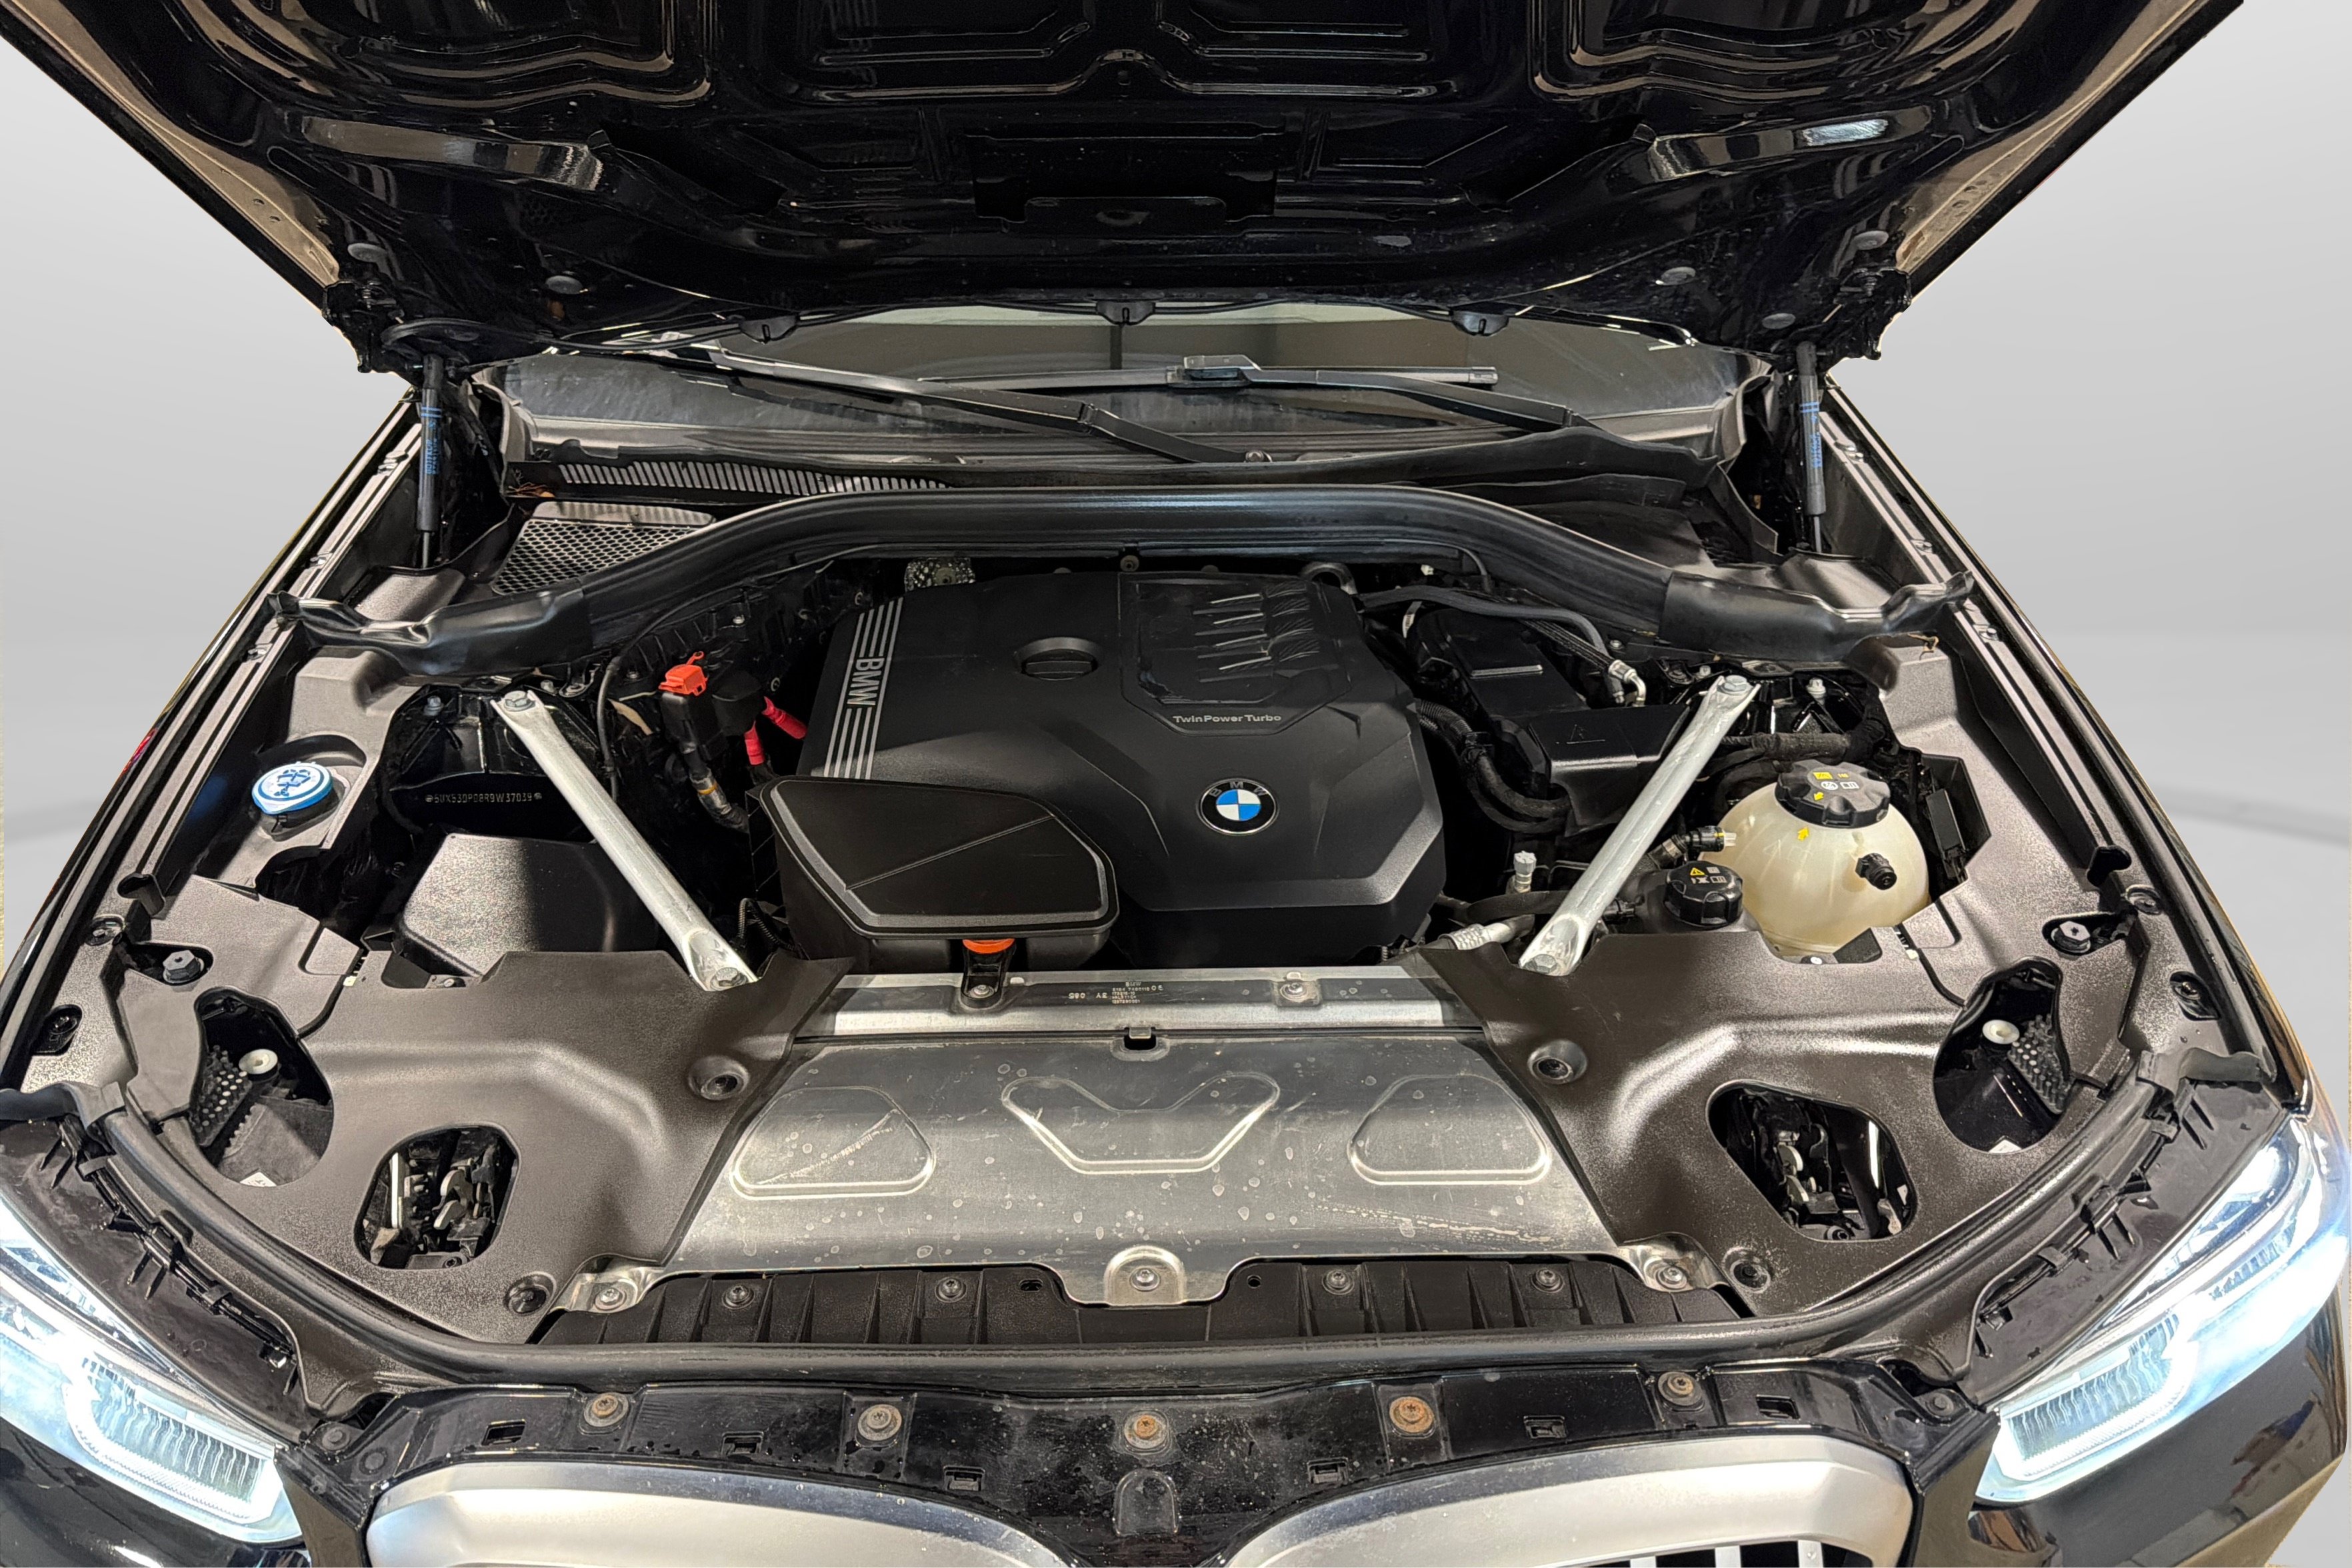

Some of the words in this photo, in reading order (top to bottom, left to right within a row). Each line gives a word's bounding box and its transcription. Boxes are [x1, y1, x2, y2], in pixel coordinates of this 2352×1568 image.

[847, 657, 885, 706] BMW
[1173, 715, 1243, 723] TwinPower
[1244, 714, 1281, 722] Turbo
[1209, 781, 1269, 797] BMW
